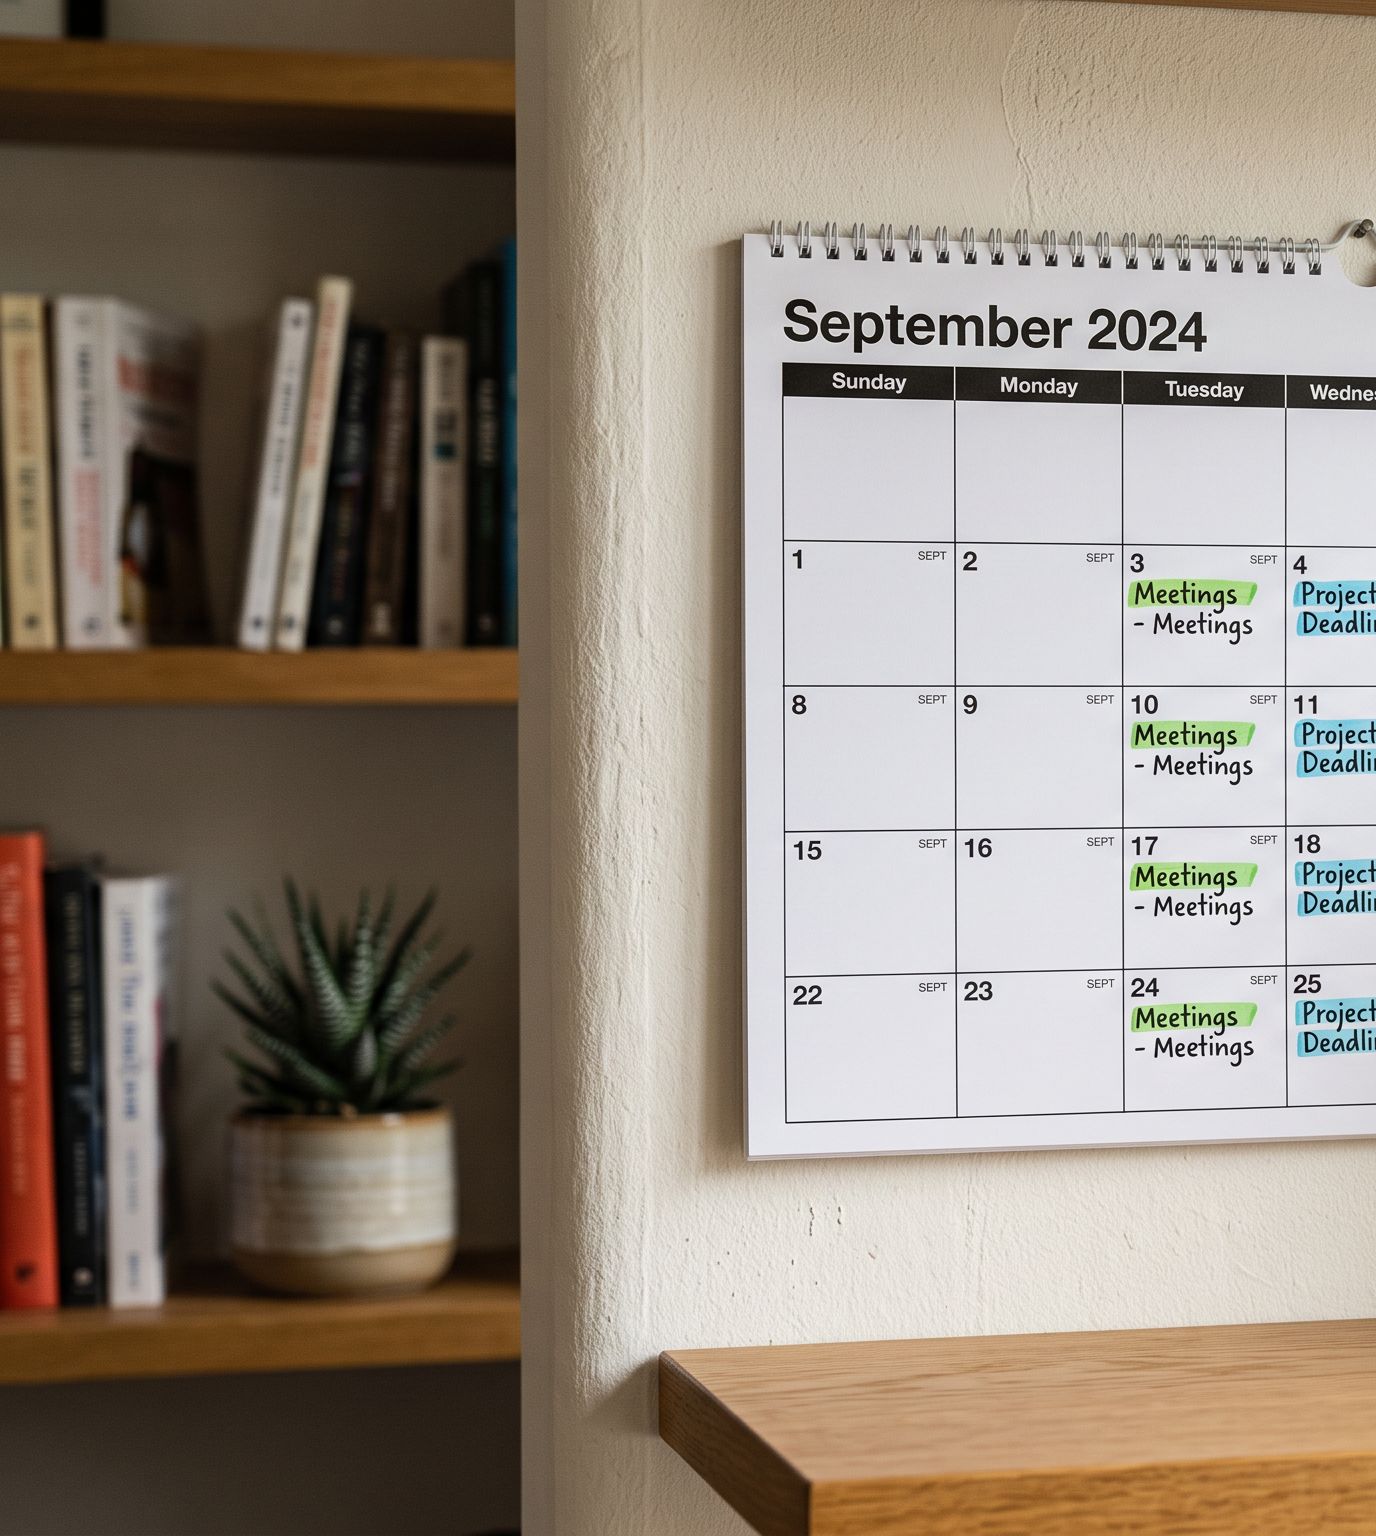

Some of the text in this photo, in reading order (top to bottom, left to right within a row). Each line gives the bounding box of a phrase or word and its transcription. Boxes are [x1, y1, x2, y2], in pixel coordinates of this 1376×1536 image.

[783, 298, 1208, 354] September 2024
[832, 371, 907, 394] Sunday
[1000, 376, 1079, 398] Monday
[1164, 380, 1245, 402] Tuesday
[792, 549, 802, 569] 1
[917, 550, 947, 561] SEPT
[962, 551, 978, 571] 2
[1086, 552, 1115, 563] SEPT
[1130, 553, 1145, 573] 3
[1249, 554, 1278, 565] SEPT
[1292, 555, 1308, 575] 4
[1134, 580, 1238, 615] Meetings
[1153, 611, 1253, 645] Meetings
[791, 694, 807, 715] 8
[918, 694, 947, 705] SEPT
[963, 694, 978, 715] 9
[1086, 694, 1114, 705] SEPT
[1131, 694, 1159, 715] 10
[1249, 694, 1277, 705] SEPT
[1293, 694, 1317, 715] 11
[1134, 721, 1238, 756] Meetings
[1153, 752, 1253, 786] Meetings
[793, 840, 822, 861] 15
[918, 838, 948, 849] SEPT
[964, 837, 993, 858] 16
[1086, 836, 1115, 847] SEPT
[1131, 836, 1159, 856] 17
[1250, 835, 1278, 845] SEPT
[1294, 834, 1321, 854] 18
[1135, 862, 1238, 897] Meetings
[1153, 892, 1254, 926] Meetings
[918, 982, 948, 993] SEPT
[963, 980, 993, 1001] 23
[1087, 978, 1116, 989] SEPT
[1130, 977, 1160, 998] 24
[1250, 975, 1278, 985] SEPT
[1293, 974, 1322, 994] 25
[793, 984, 823, 1006] 22
[1135, 1003, 1238, 1037] Meetings
[1154, 1034, 1255, 1067] Meetings
